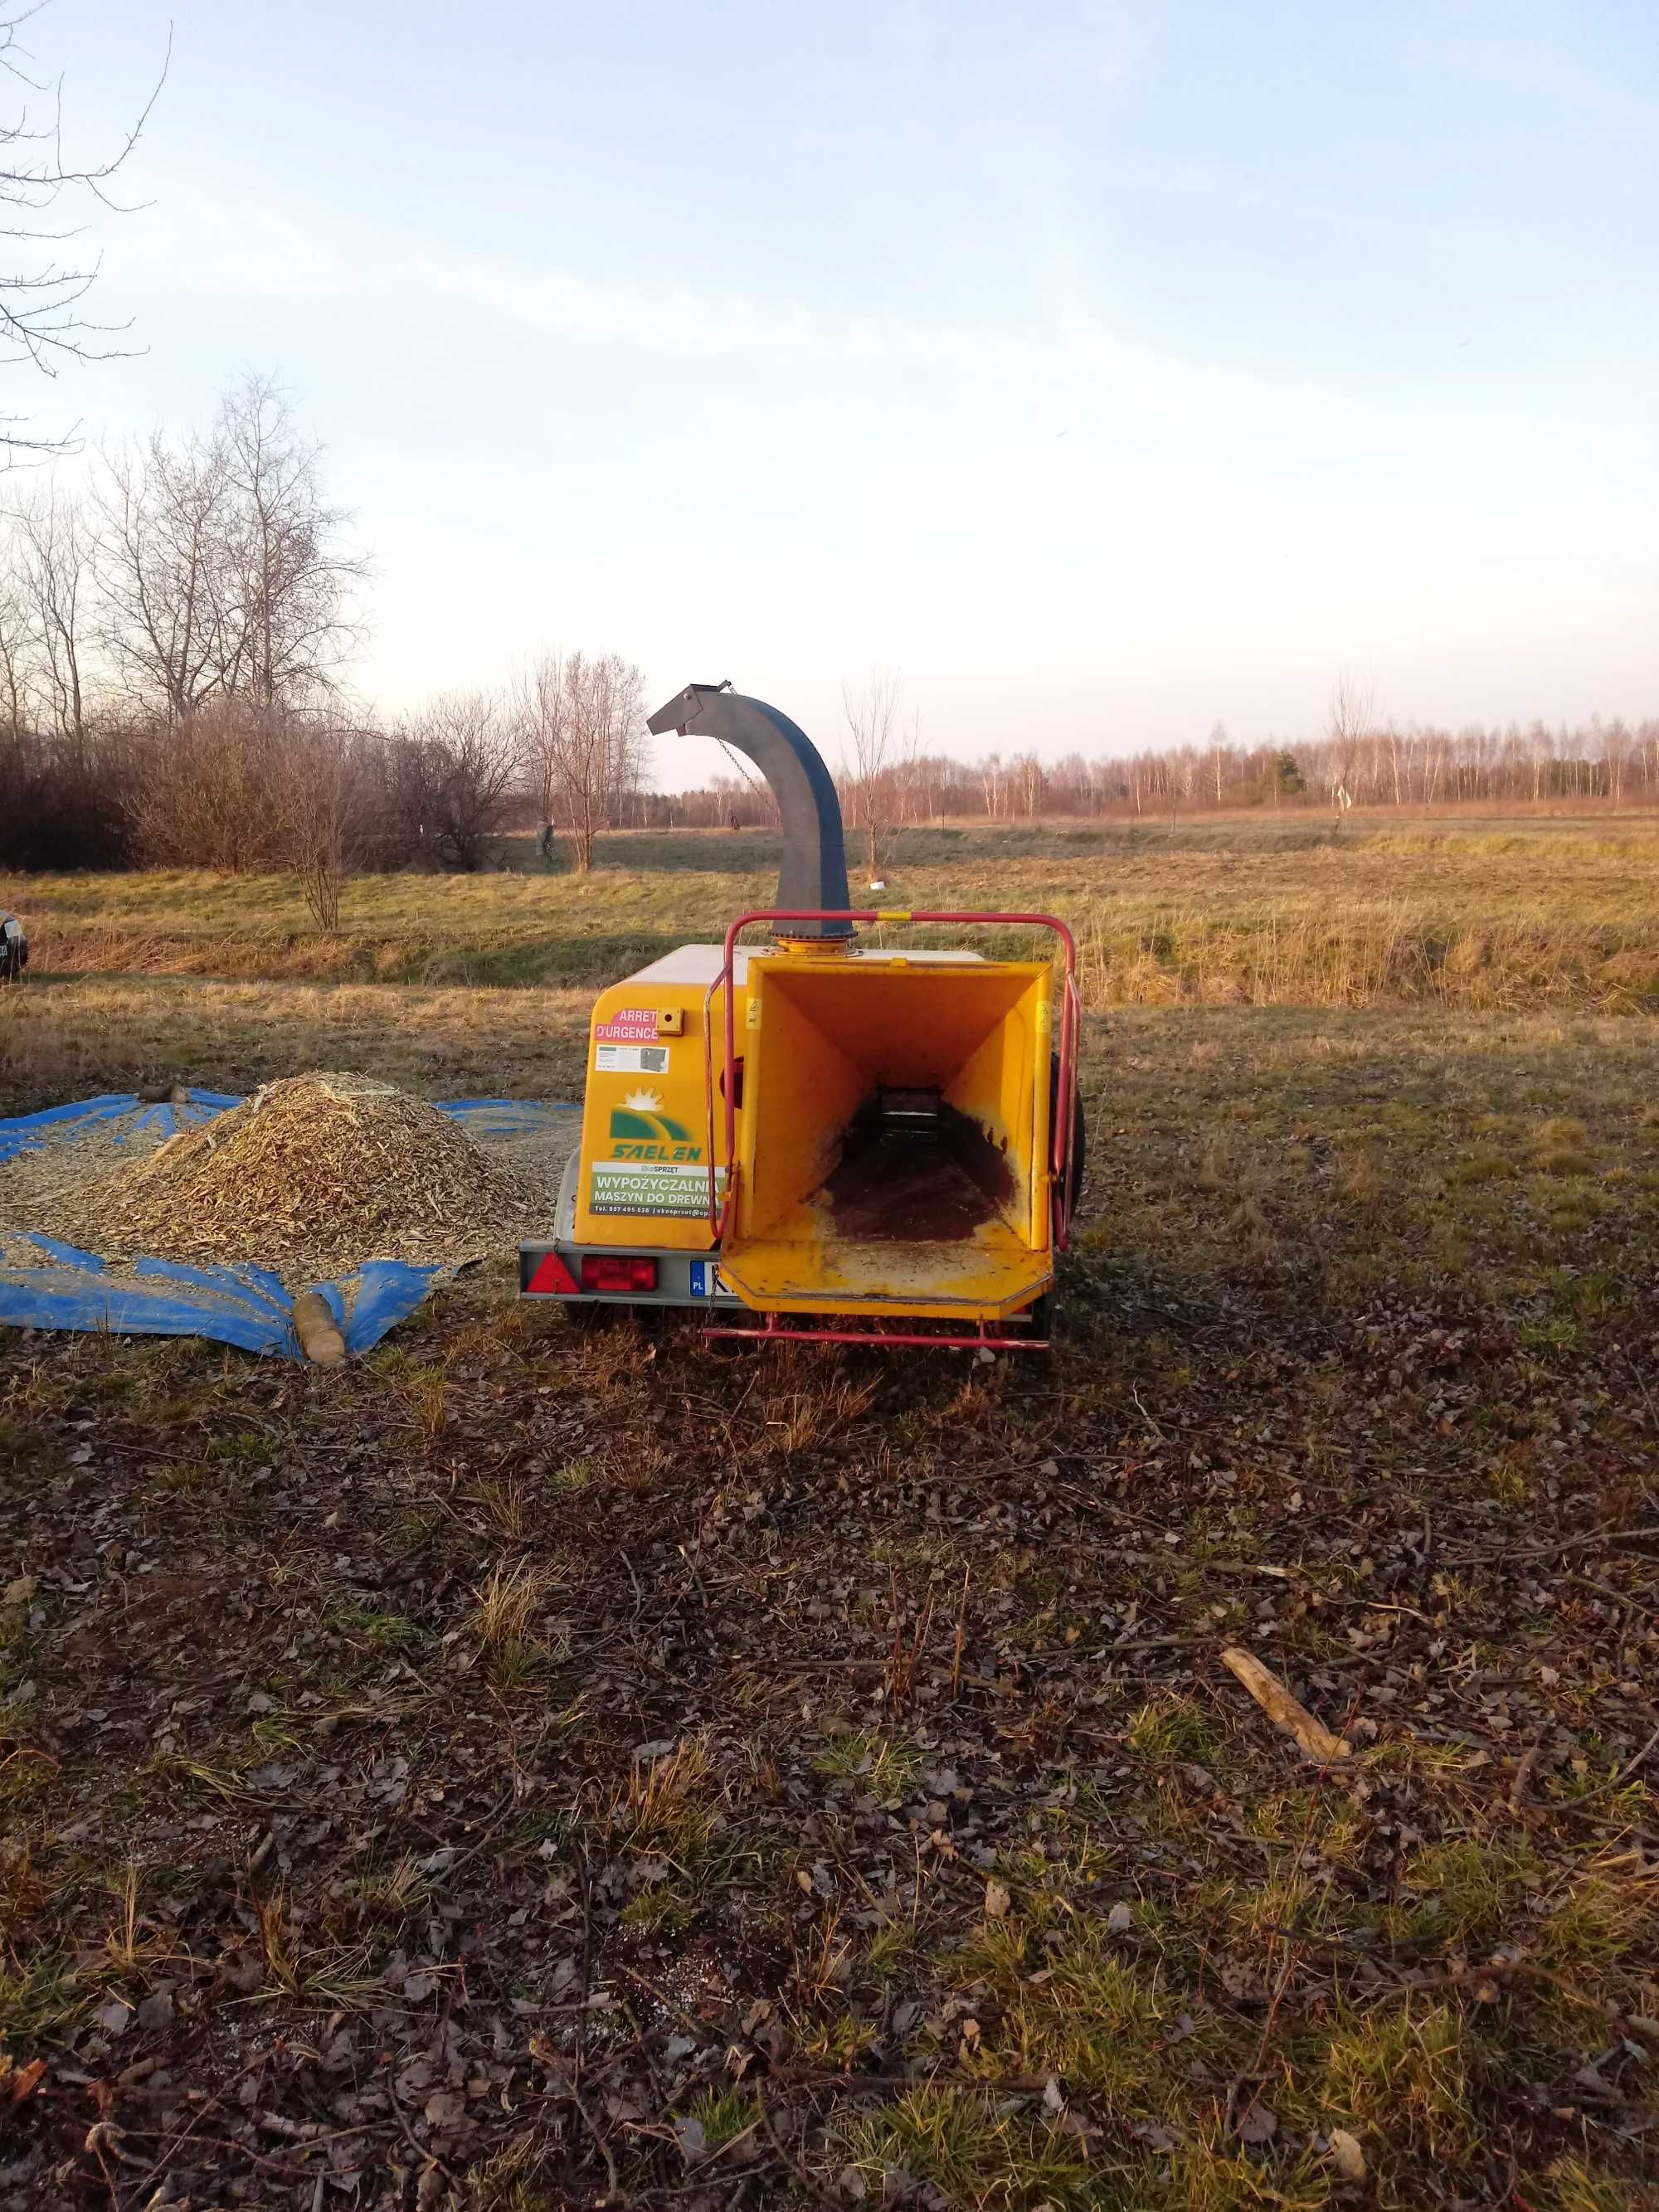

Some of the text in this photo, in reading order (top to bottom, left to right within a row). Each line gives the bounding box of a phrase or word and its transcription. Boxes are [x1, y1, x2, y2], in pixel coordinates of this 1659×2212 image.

[620, 1010, 657, 1023] ARRET
[597, 1026, 658, 1039] D'URGENCE
[611, 1145, 701, 1161] SAELEN
[594, 1191, 644, 1202] MASZYN
[647, 1194, 664, 1203] DO
[693, 1281, 703, 1290] PL
